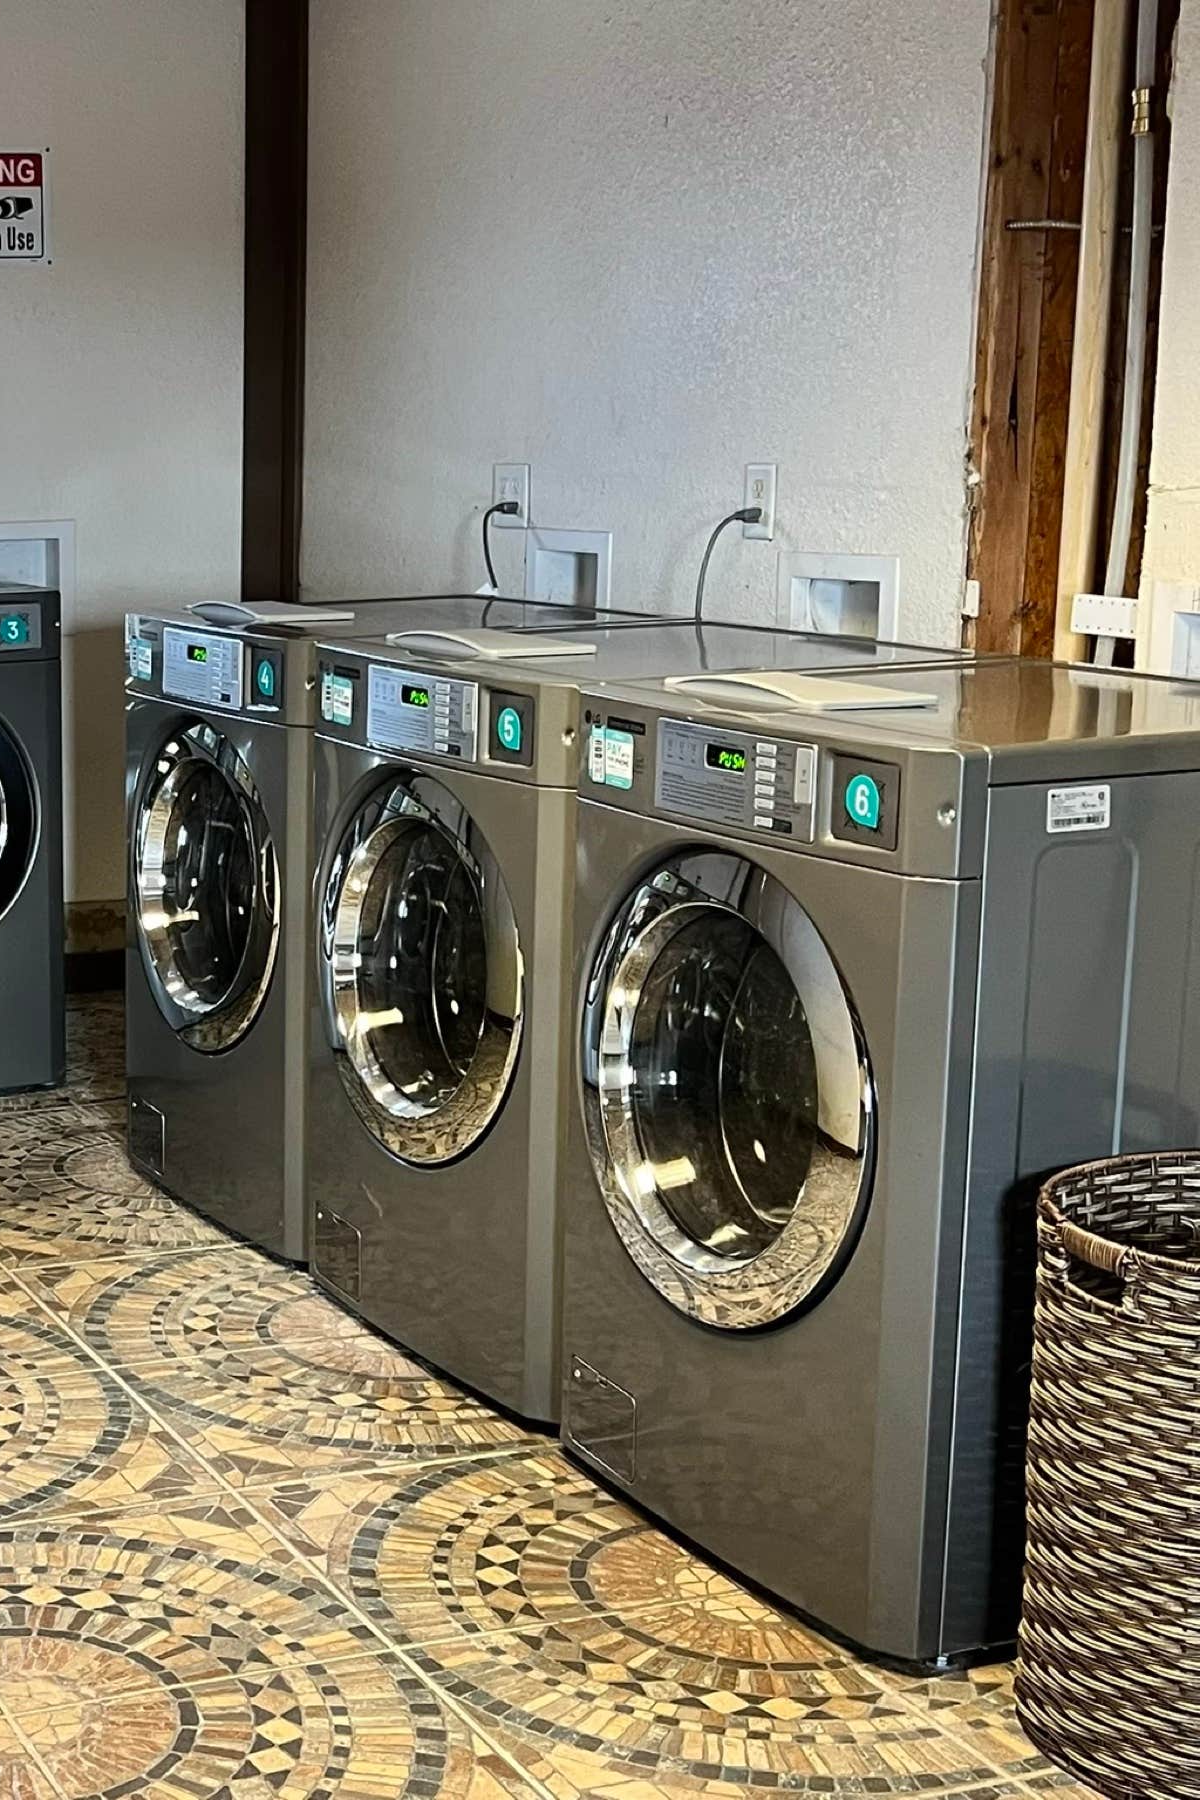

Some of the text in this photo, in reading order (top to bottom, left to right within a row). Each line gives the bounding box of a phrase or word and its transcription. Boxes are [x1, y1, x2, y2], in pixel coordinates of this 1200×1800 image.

[7, 226, 35, 251] Use
[7, 621, 19, 640] 3
[260, 666, 269, 689] 4
[503, 715, 514, 742] 5
[718, 751, 745, 769] PUSH
